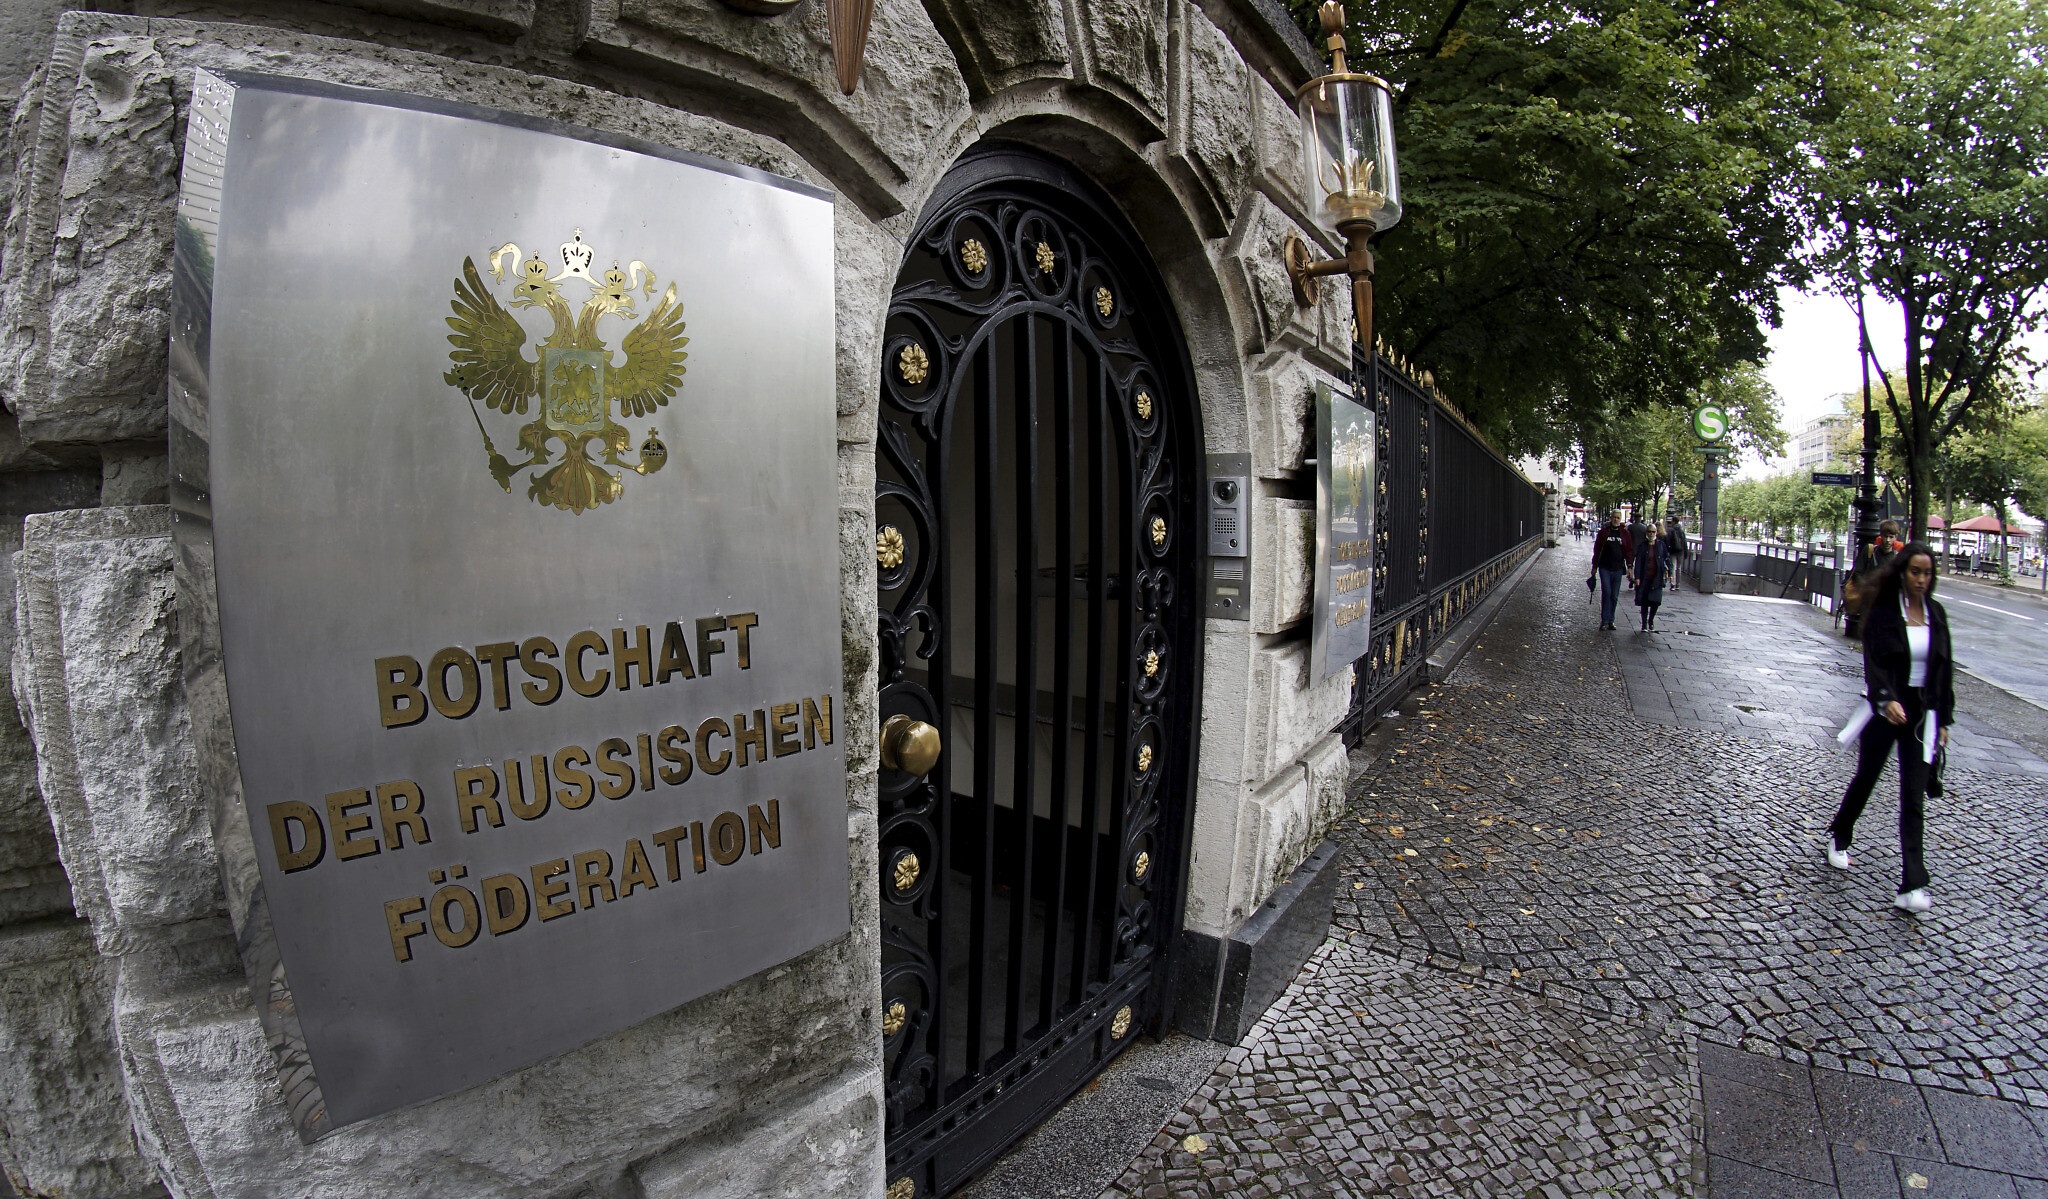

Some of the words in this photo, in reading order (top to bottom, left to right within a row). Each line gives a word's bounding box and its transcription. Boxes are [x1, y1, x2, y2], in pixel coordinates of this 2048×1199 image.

[1699, 407, 1723, 438] S
[375, 612, 759, 729] BOTSCHAFT
[267, 778, 431, 874] DER
[454, 694, 834, 834] RUSSISCHEN
[384, 799, 782, 963] FÖDERATION
